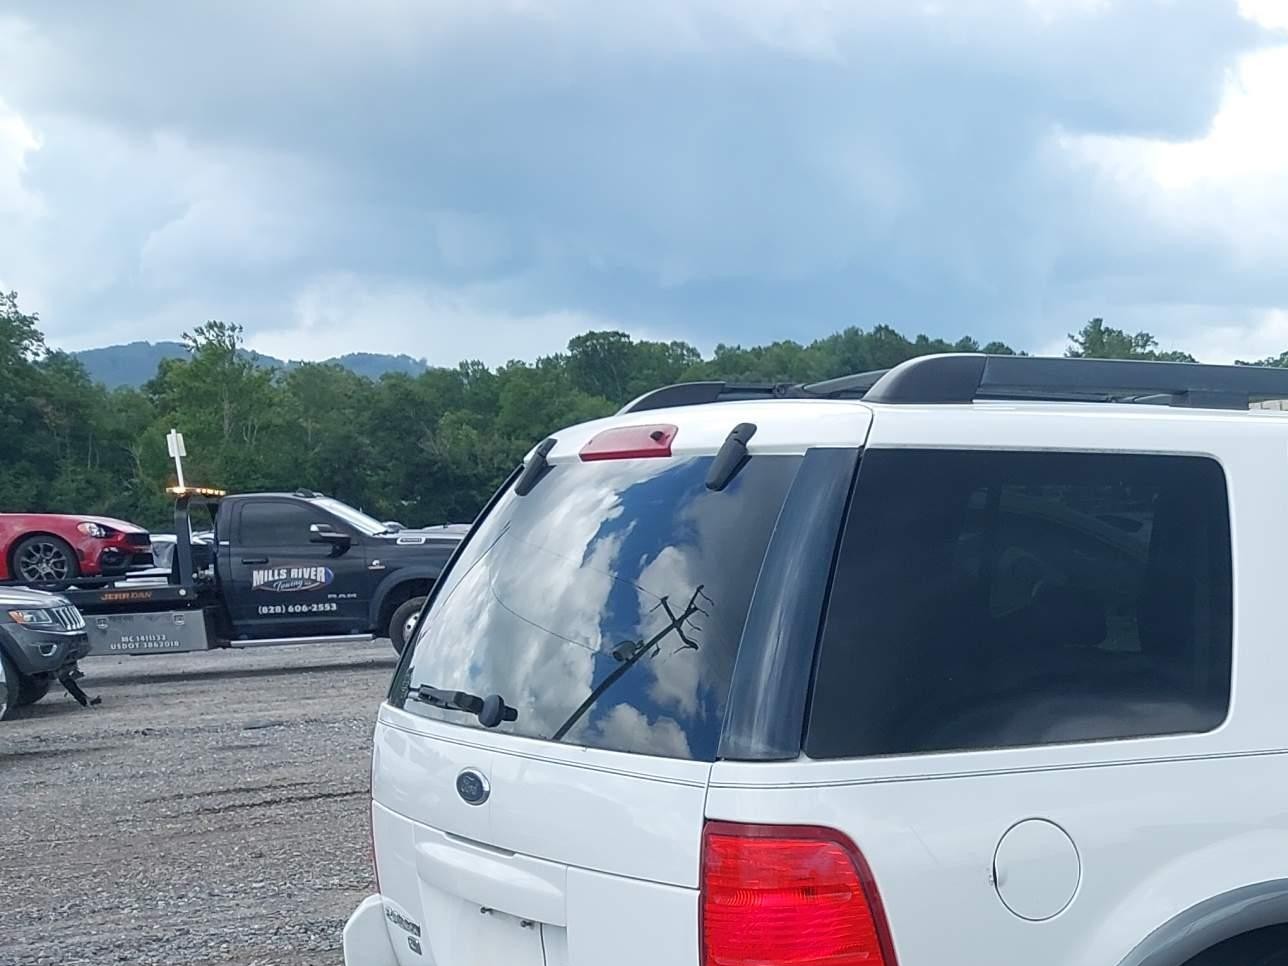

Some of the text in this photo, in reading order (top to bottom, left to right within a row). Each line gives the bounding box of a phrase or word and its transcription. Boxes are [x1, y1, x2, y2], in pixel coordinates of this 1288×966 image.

[252, 566, 326, 588] MILLS RIVER
[288, 602, 337, 613] 606-2553
